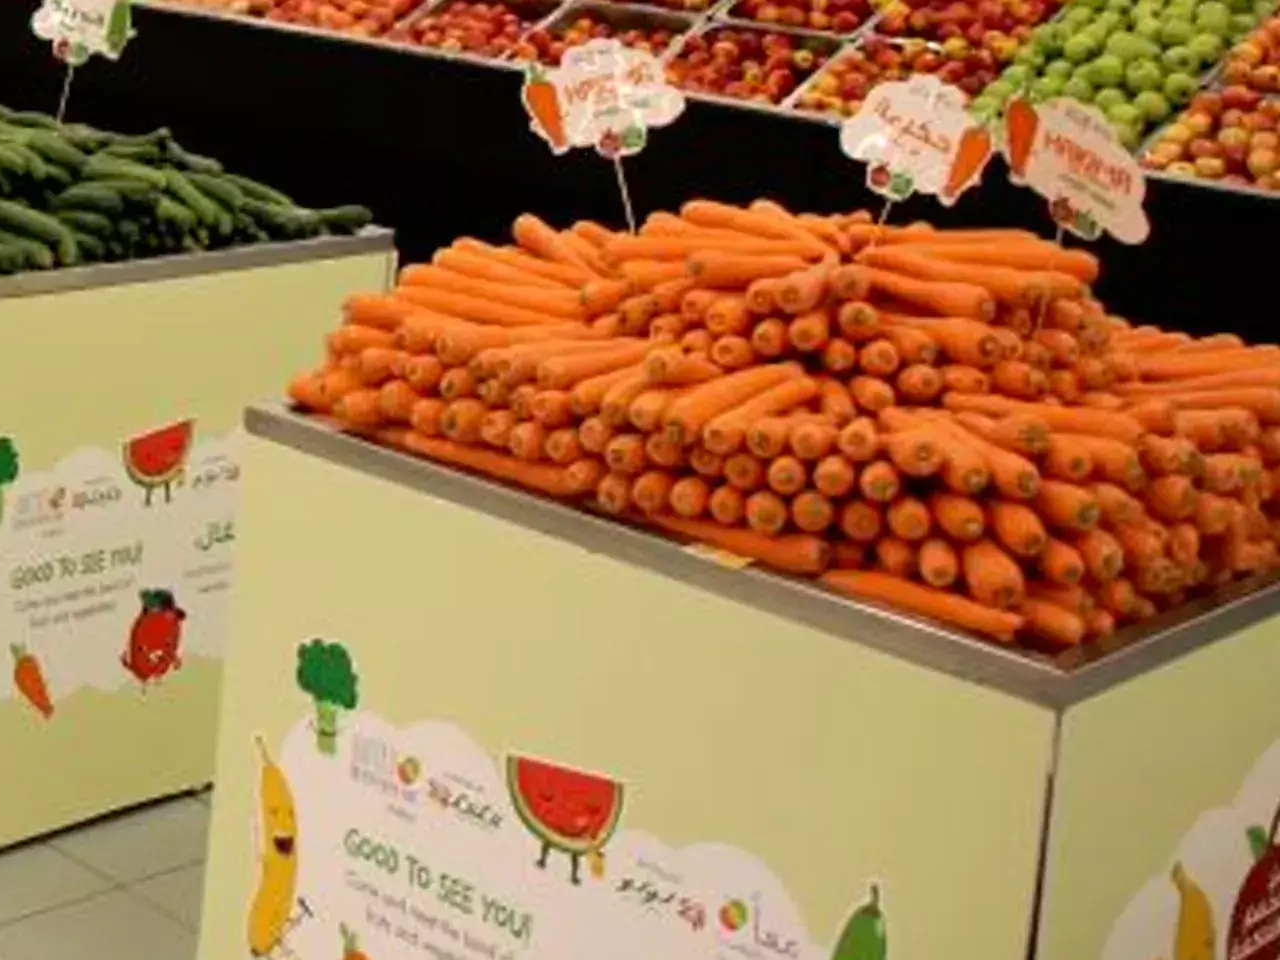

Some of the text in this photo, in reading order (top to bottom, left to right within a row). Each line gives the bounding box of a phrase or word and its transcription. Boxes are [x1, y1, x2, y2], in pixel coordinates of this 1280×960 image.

[343, 828, 400, 875] GOOD
[406, 853, 431, 890] TO
[436, 871, 476, 915] SEE
